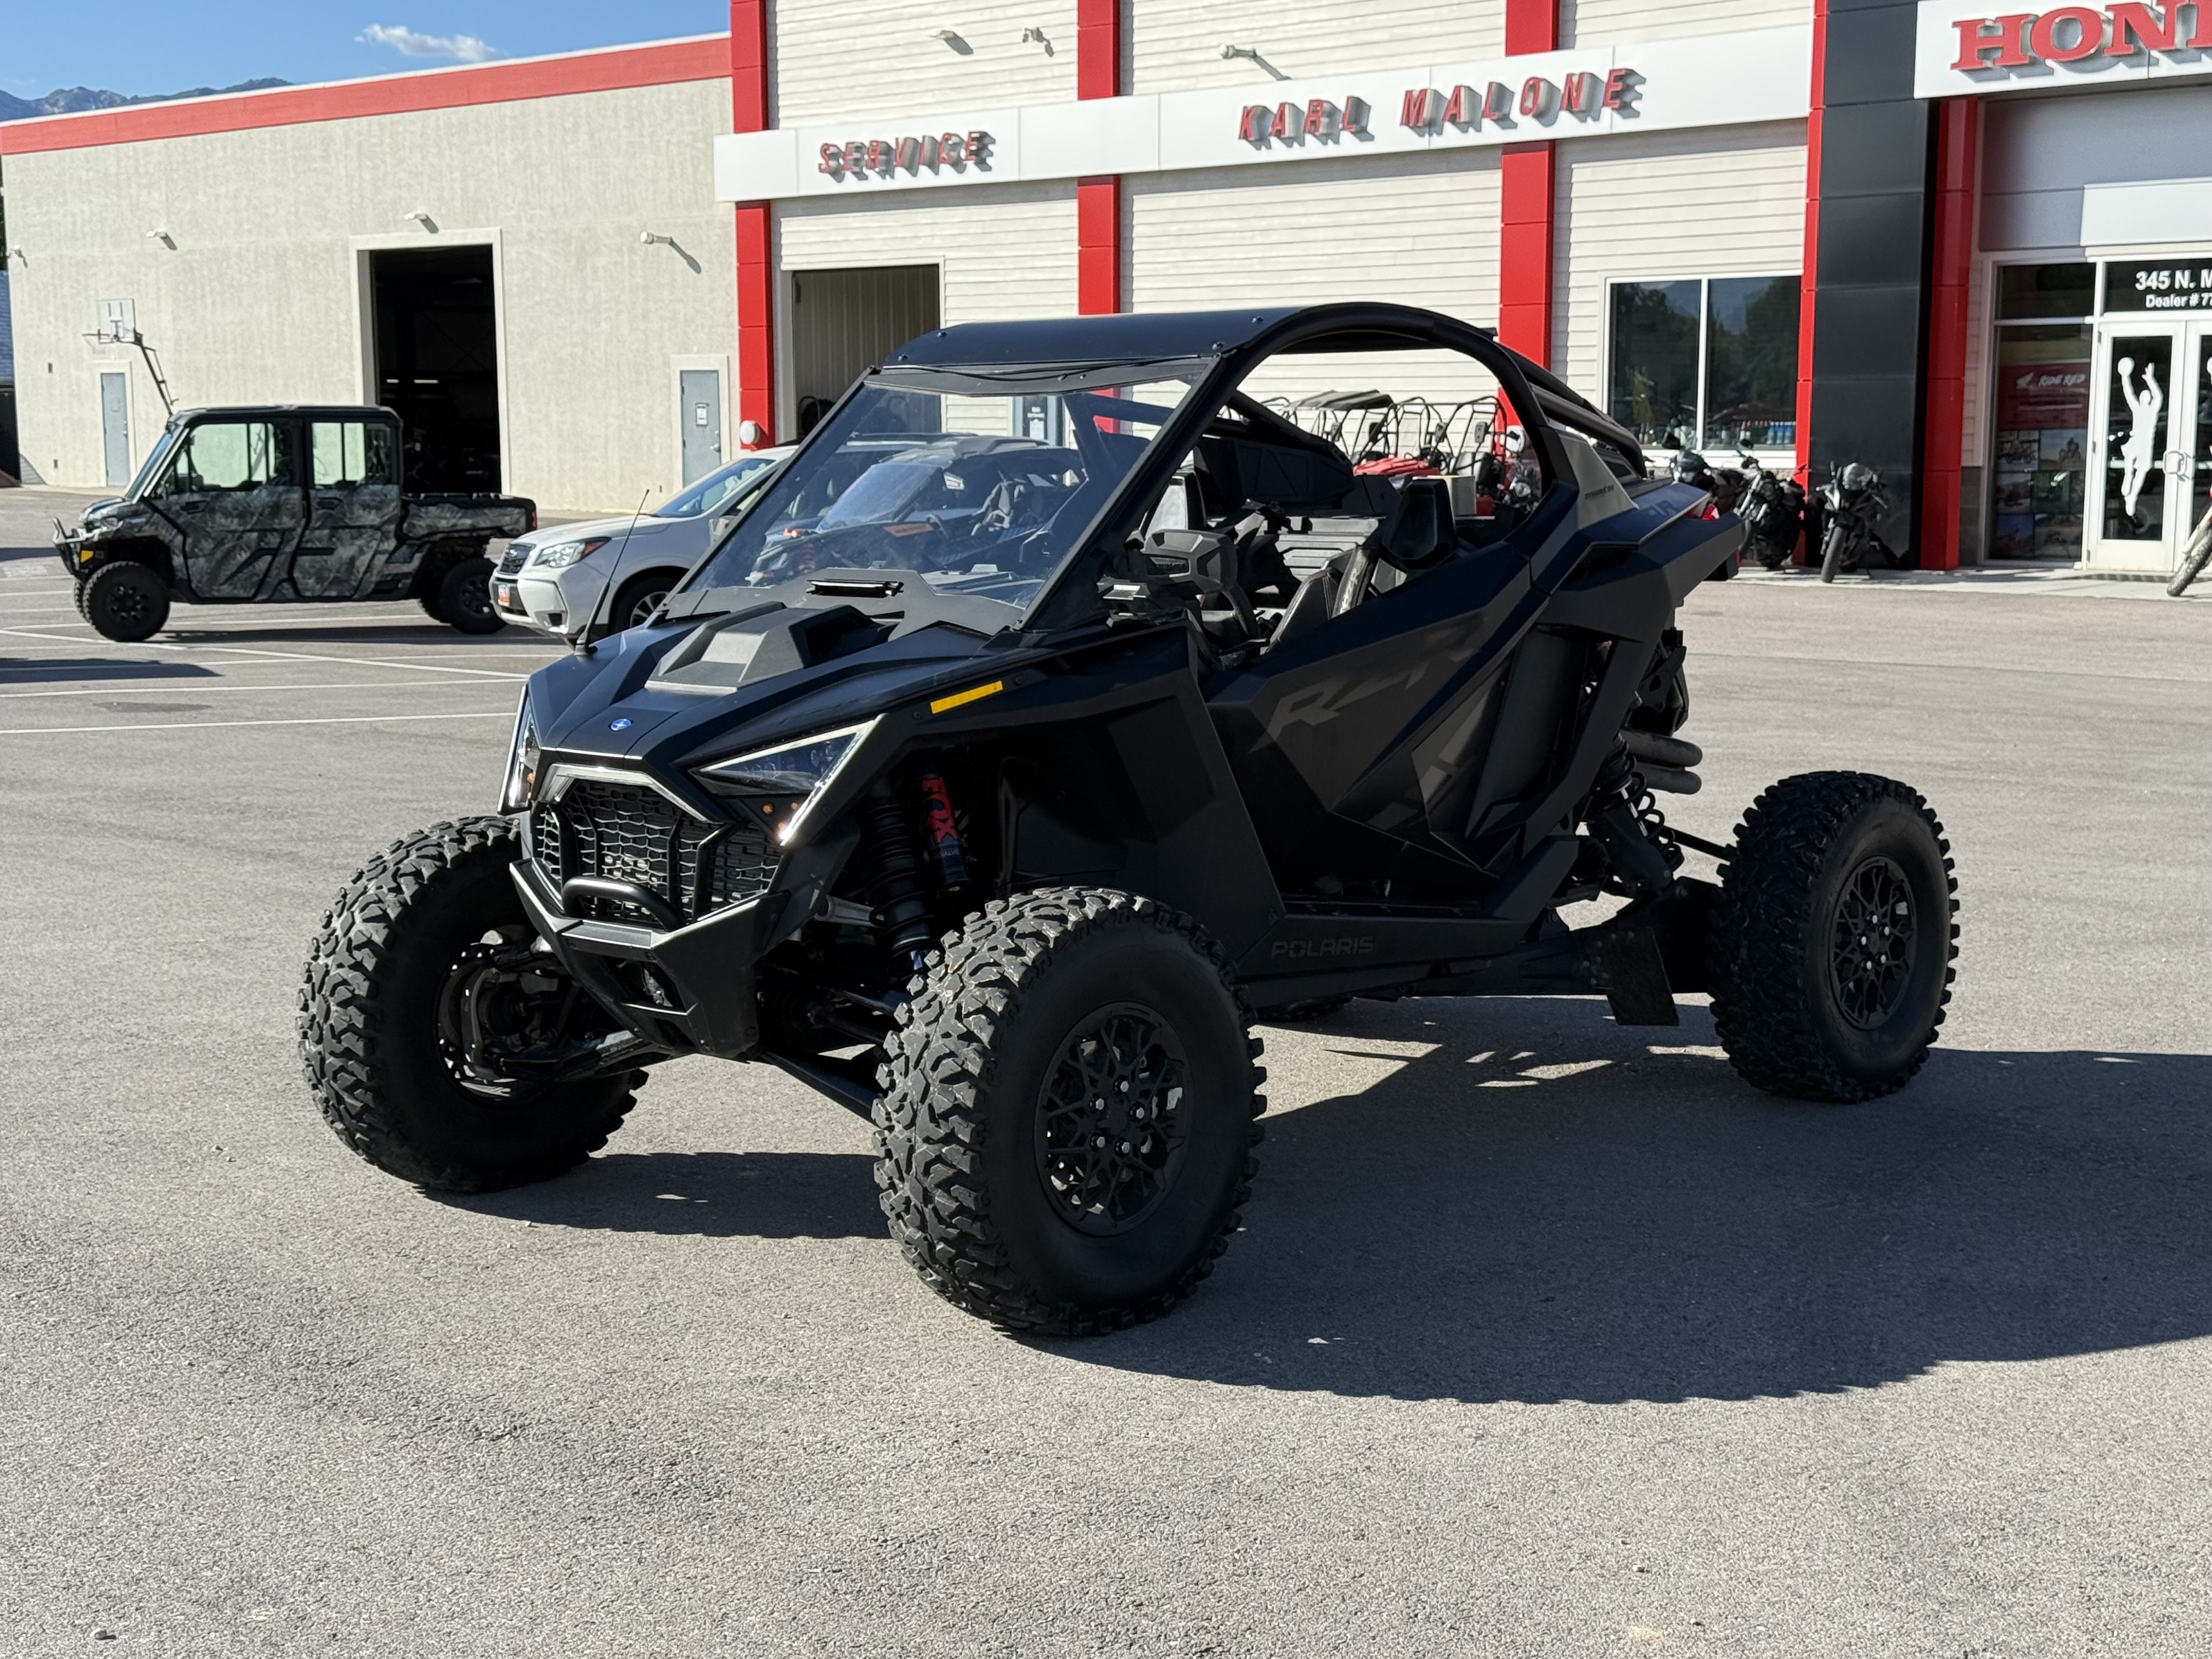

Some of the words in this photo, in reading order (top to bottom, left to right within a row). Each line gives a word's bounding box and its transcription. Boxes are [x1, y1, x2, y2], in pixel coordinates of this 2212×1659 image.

[1238, 95, 1364, 143] KARL
[1400, 68, 1630, 128] MALONE
[817, 130, 985, 176] SERVICE
[2135, 269, 2171, 291] 345
[2174, 269, 2197, 290] N.
[2145, 292, 2188, 308] Dealer
[2038, 374, 2064, 387] RIDE
[923, 777, 959, 843] FOX
[1271, 936, 1374, 959] POLARIS
